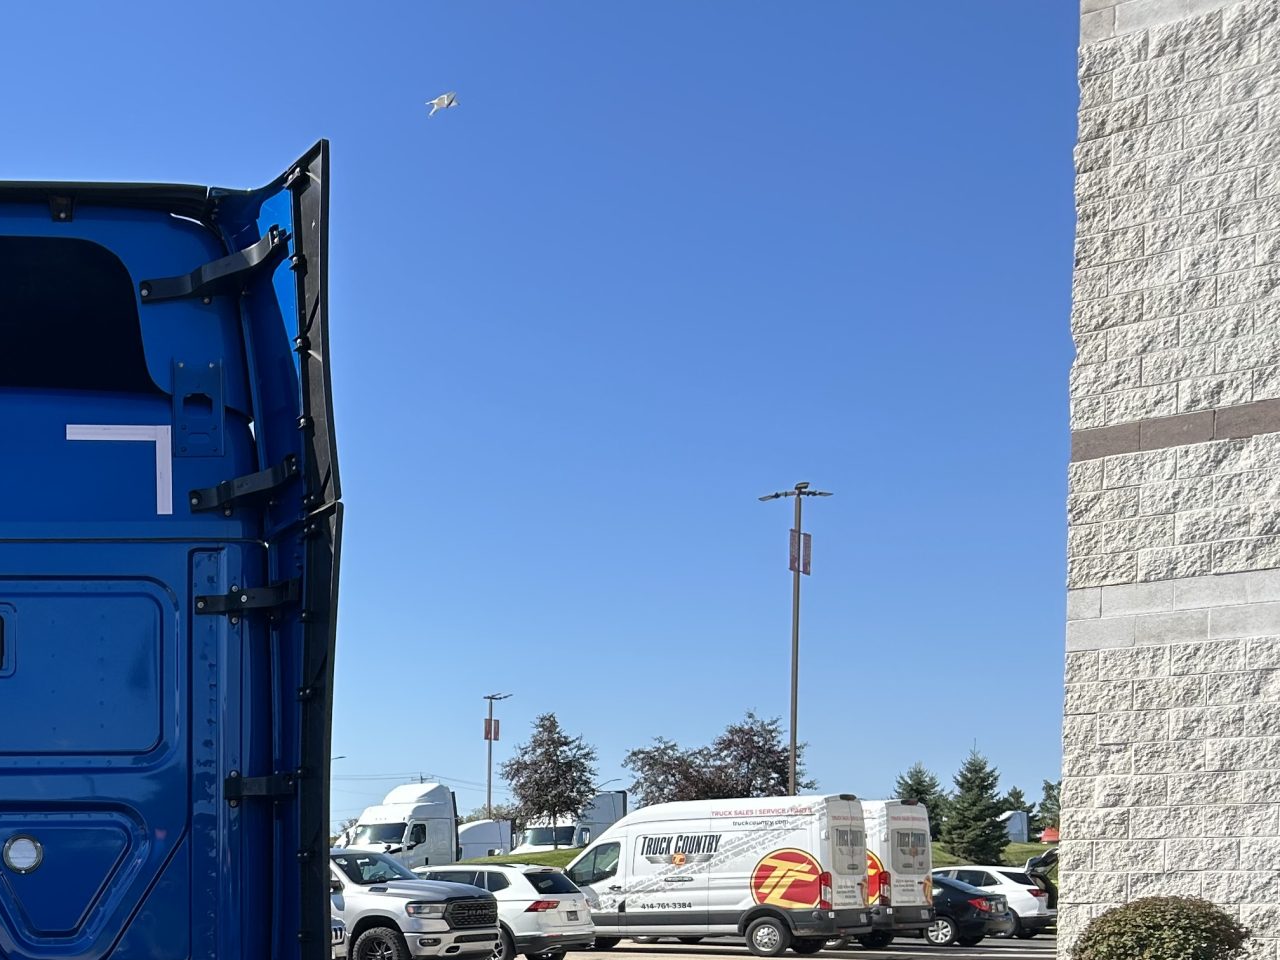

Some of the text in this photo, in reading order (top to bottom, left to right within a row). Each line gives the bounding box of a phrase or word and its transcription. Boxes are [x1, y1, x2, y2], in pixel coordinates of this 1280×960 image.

[732, 819, 789, 827] truckcountry.com
[641, 834, 722, 855] TRUCK COUNTRY
